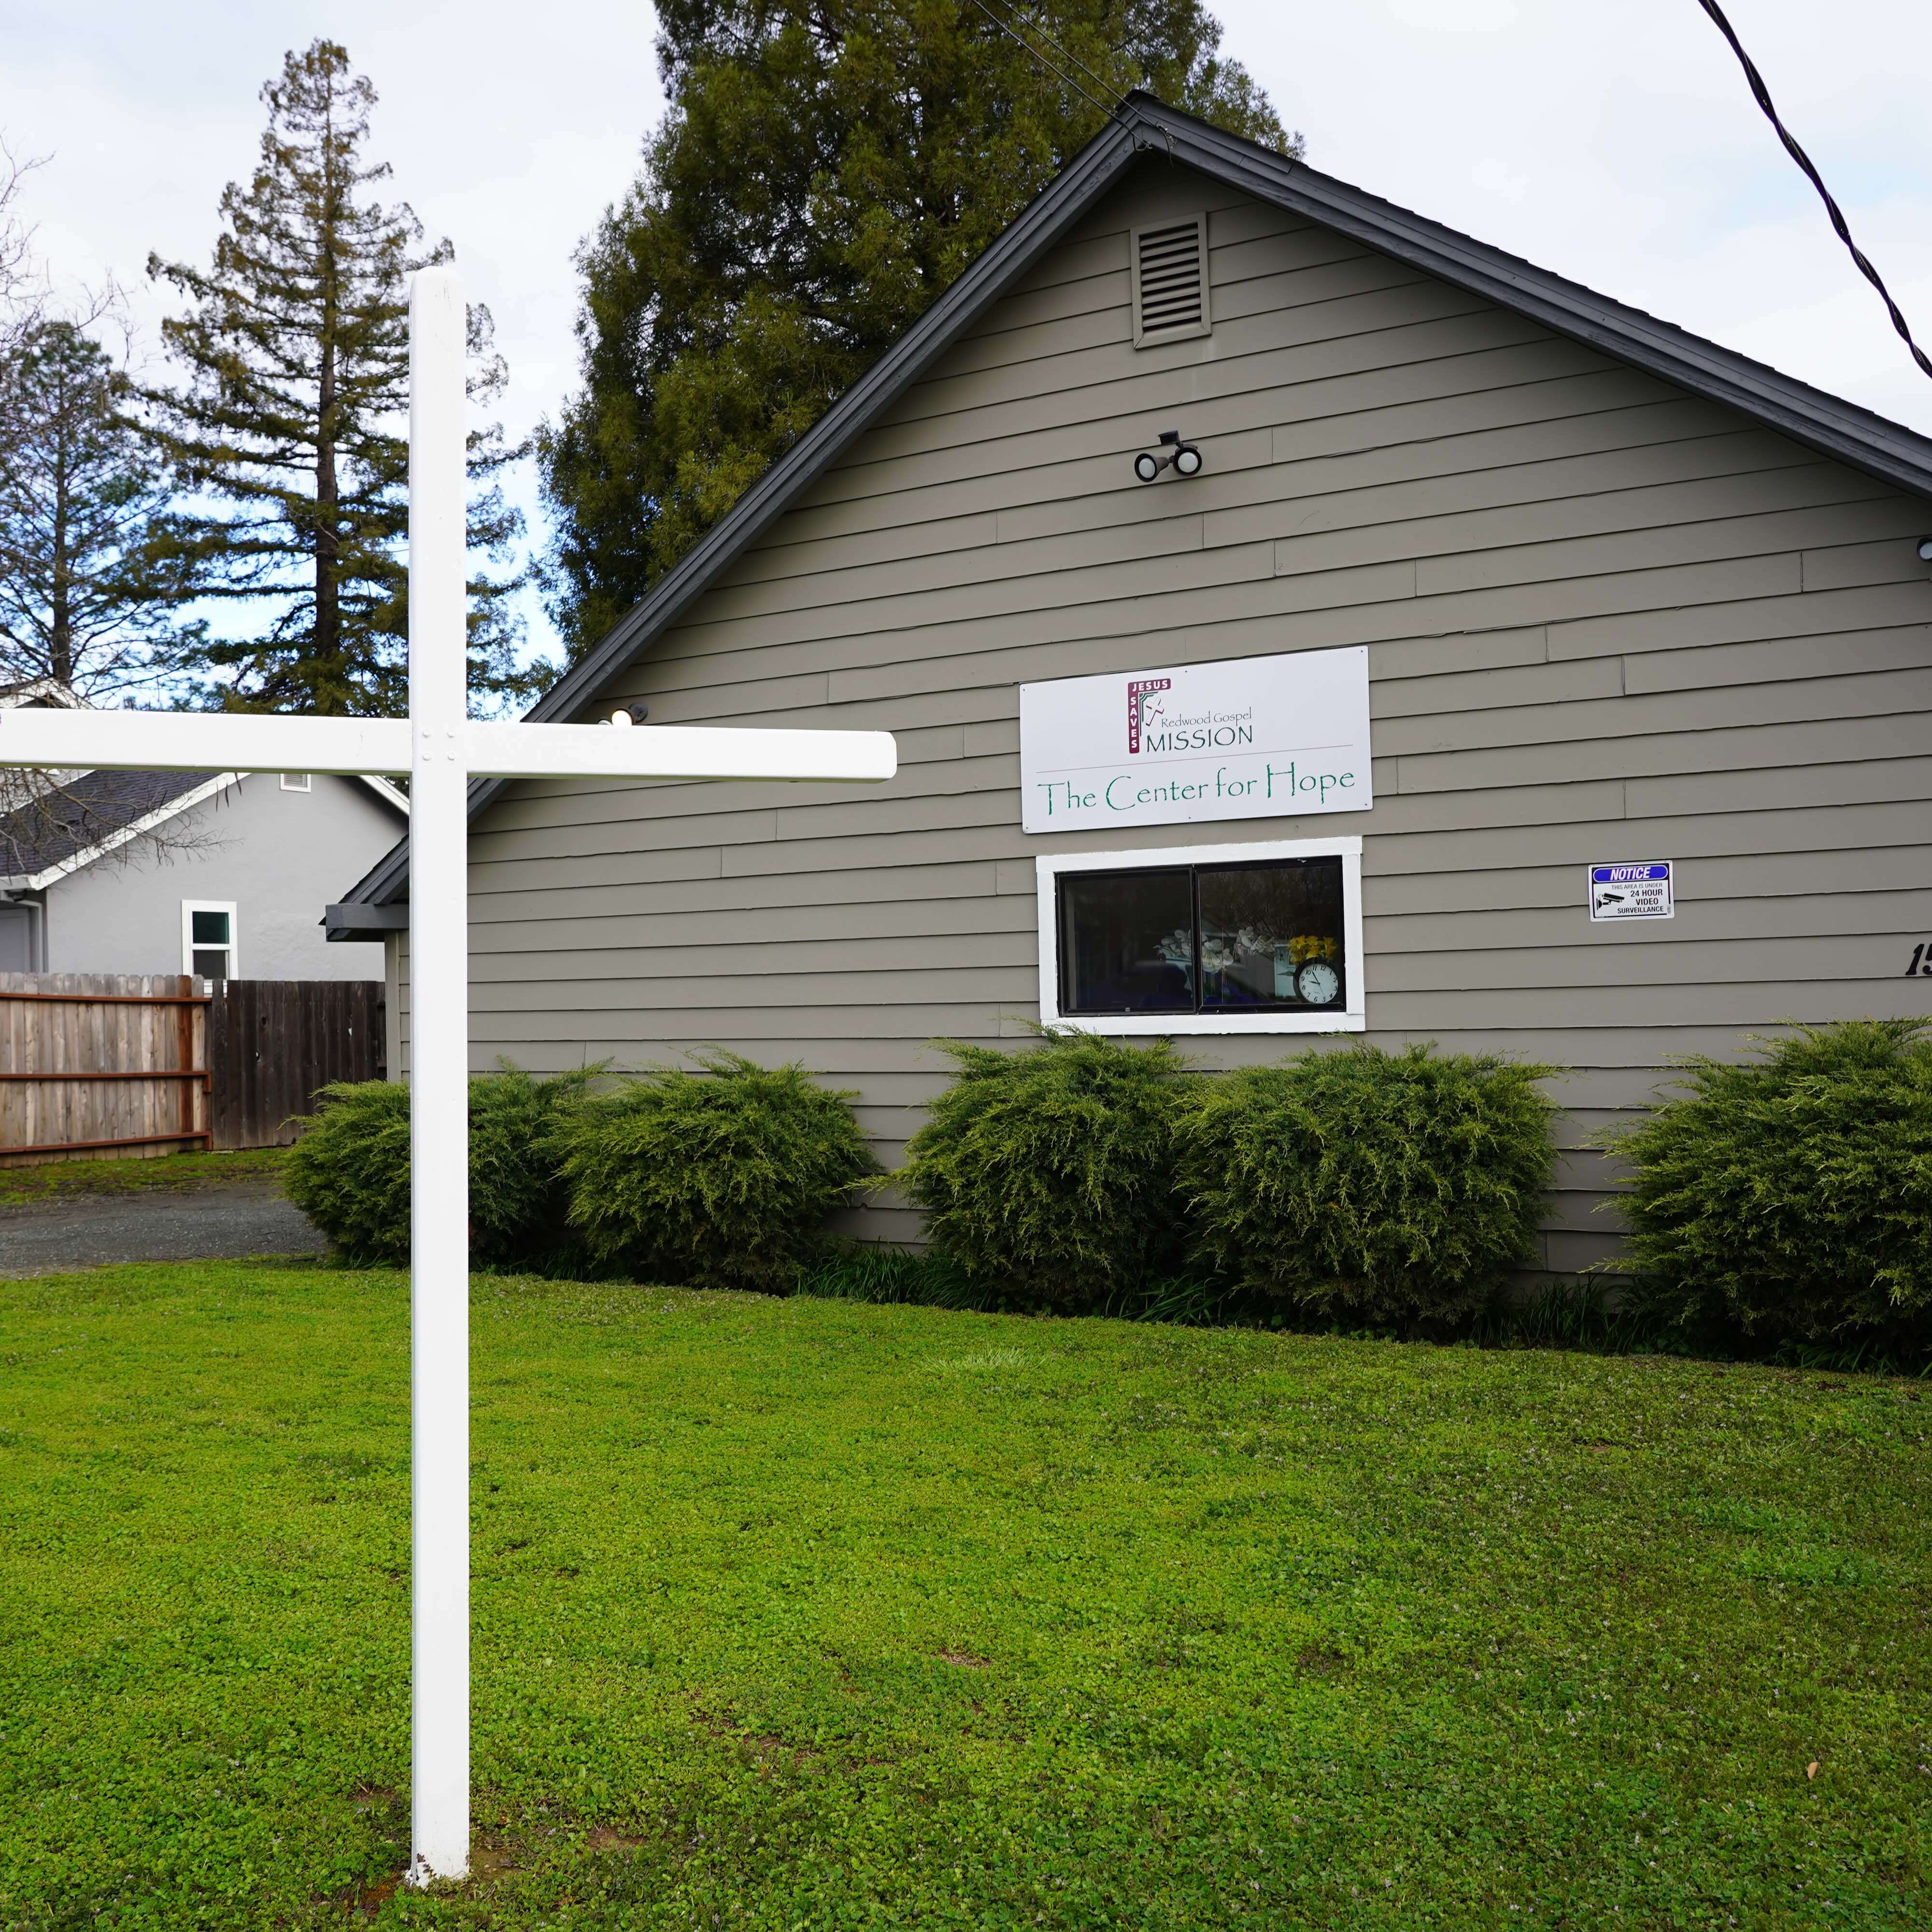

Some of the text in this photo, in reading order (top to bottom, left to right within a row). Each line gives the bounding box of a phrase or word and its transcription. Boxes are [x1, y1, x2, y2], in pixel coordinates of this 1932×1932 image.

[1132, 680, 1168, 692] JESUS
[1161, 707, 1251, 727] Redwood Gospel
[1147, 725, 1252, 753] MISSION
[1037, 762, 1355, 815] The Center for Hope
[1610, 867, 1651, 881] NOTICE
[1617, 906, 1664, 914] SURVEILLANCE
